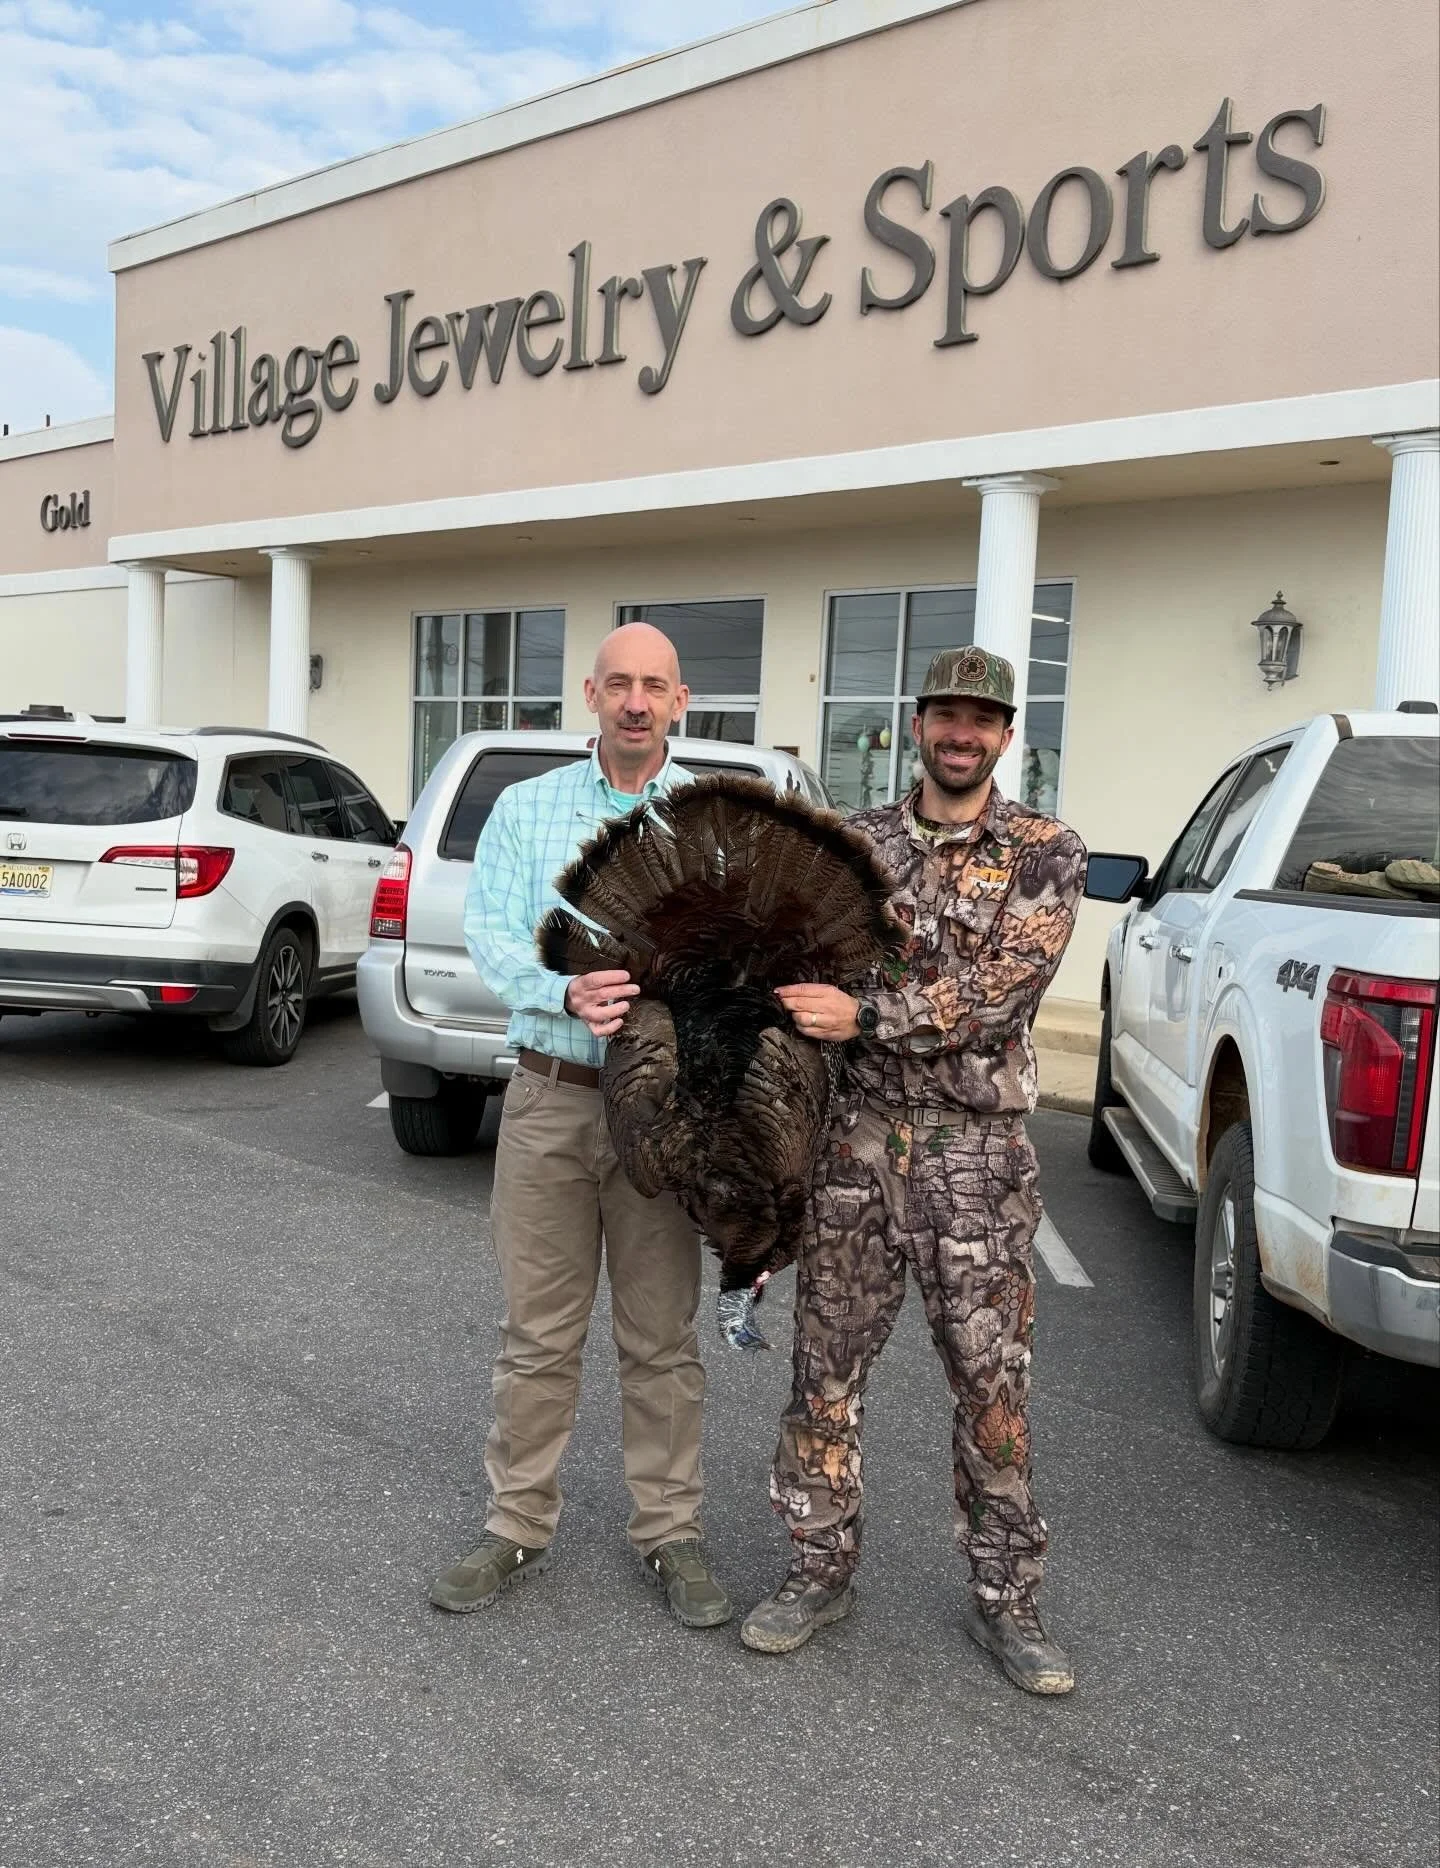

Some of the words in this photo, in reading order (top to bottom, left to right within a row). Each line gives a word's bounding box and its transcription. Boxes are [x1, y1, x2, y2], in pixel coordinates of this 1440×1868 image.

[142, 325, 360, 449] Village
[374, 240, 708, 404] Jewelry
[730, 197, 833, 337] &
[859, 97, 1327, 348] Sports
[40, 489, 91, 533] Gold
[1, 870, 48, 890] 5A0002
